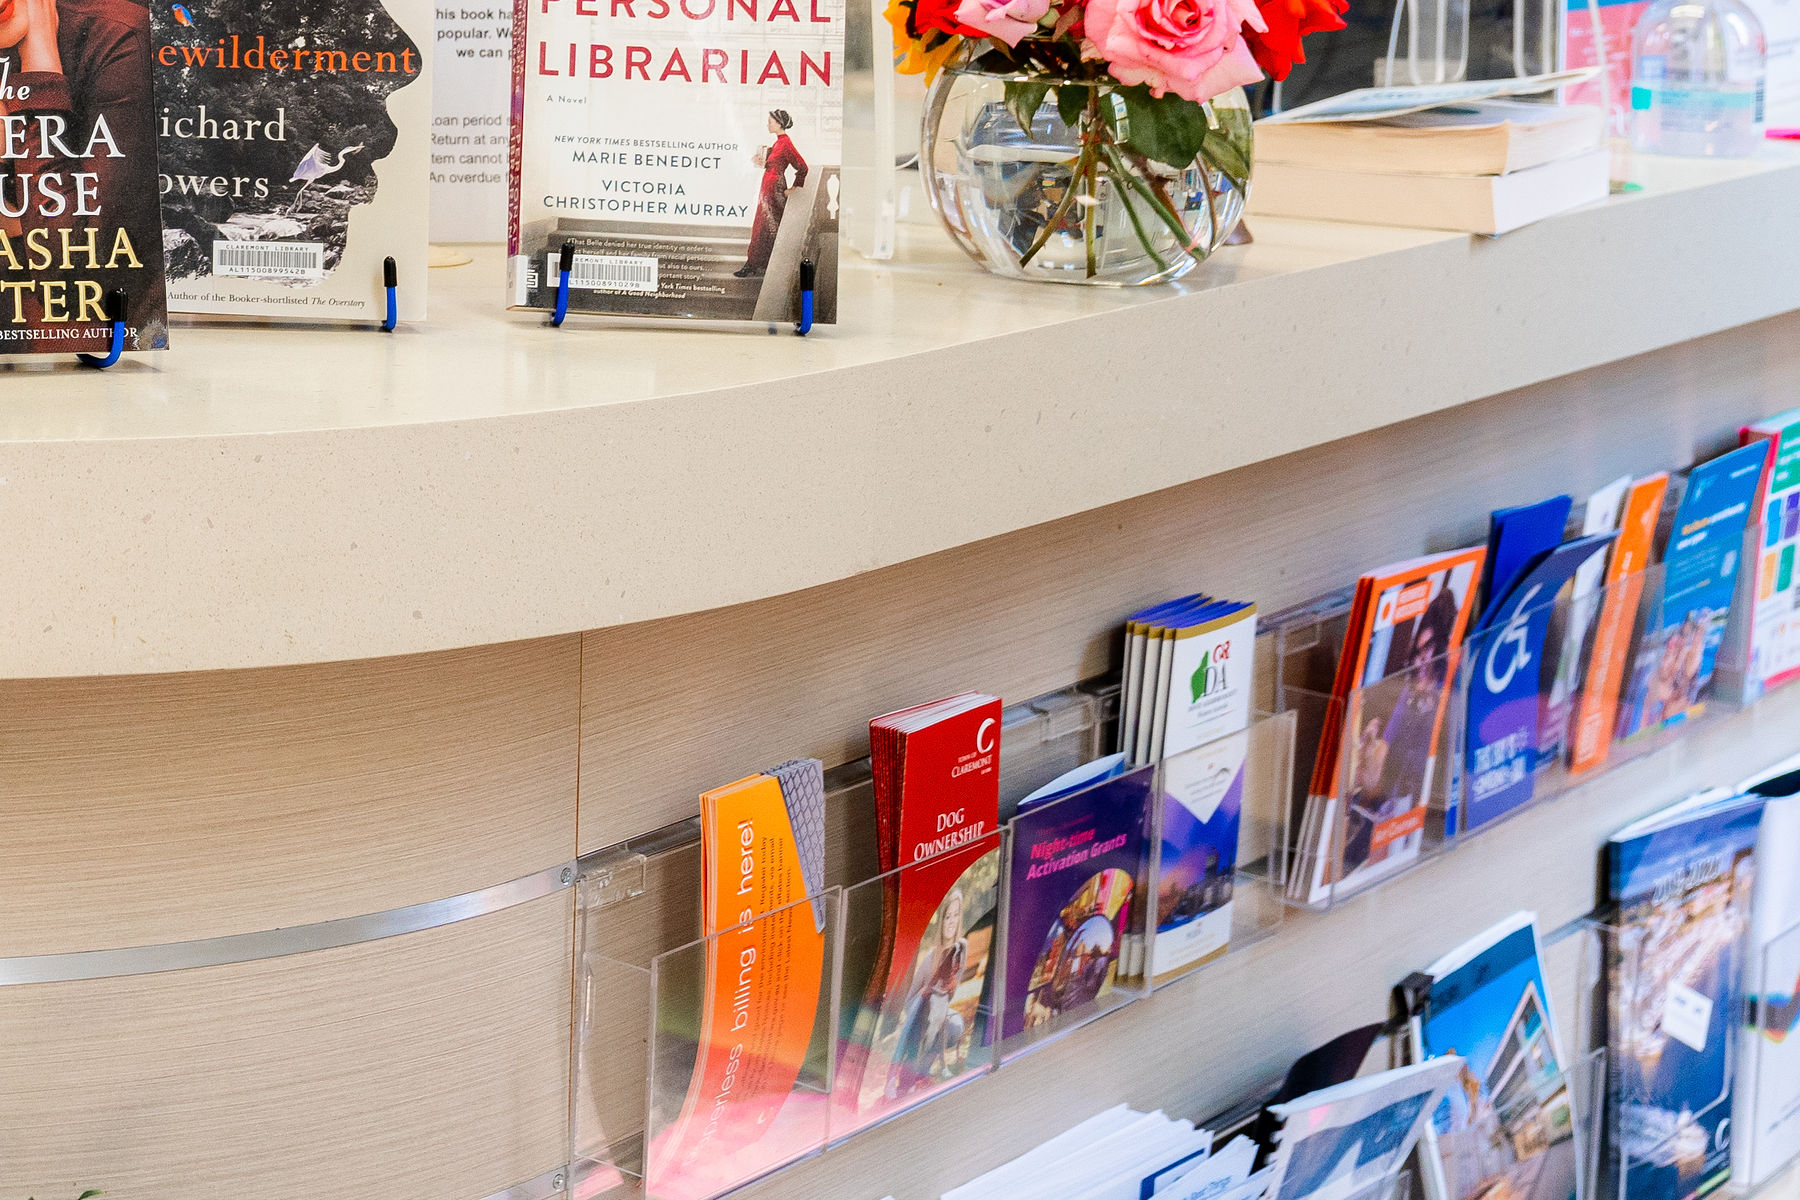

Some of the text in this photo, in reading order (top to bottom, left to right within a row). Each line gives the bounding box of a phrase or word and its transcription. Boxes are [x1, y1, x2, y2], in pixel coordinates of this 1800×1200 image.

[460, 8, 494, 20] book
[437, 28, 491, 41] popular.
[157, 34, 416, 75] ewilderment
[538, 41, 831, 88] LIBRARIAN
[159, 105, 287, 143] ichard
[463, 113, 502, 128] period
[633, 139, 696, 150] BESTSELLING
[572, 150, 722, 169] MARIE BENEDICT
[158, 172, 269, 199] owers
[449, 171, 501, 183] overdue
[601, 179, 686, 196] VICTORIA
[543, 195, 748, 218] CHRISTOPHER MURRAY
[168, 291, 326, 306] Author Booker-shortlisted The
[936, 807, 965, 832] DOG
[913, 821, 985, 861] OWNERSHIP
[1030, 828, 1096, 860] Night-time
[1026, 833, 1128, 881] Activation Grants
[731, 818, 757, 1034] billing is here!
